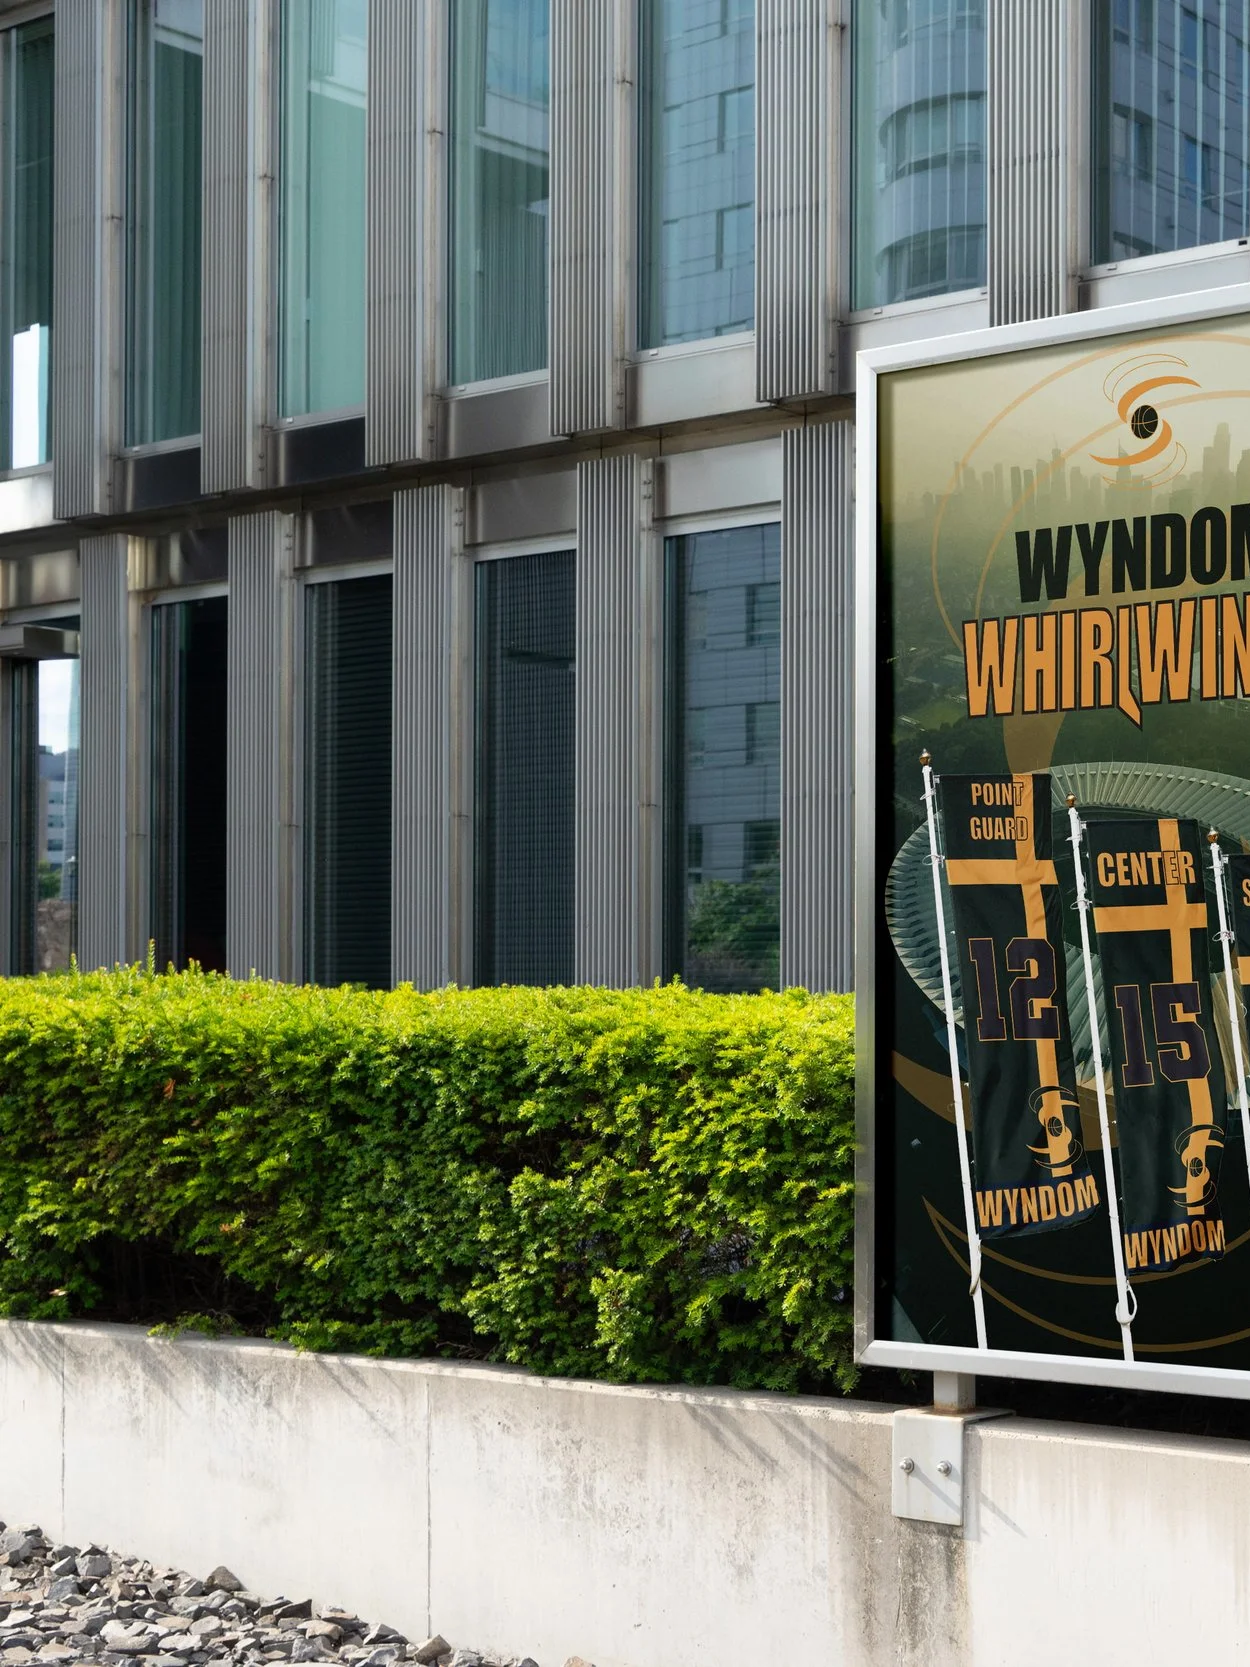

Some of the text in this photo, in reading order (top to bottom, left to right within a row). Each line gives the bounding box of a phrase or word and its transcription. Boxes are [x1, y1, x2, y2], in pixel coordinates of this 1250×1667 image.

[971, 781, 1024, 806] POINT
[969, 815, 1029, 841] GUARD
[1097, 850, 1197, 887] CENTER
[968, 936, 1060, 1041] 12
[1114, 981, 1211, 1088] 15
[976, 1173, 1099, 1228] WYNDOM
[1125, 1219, 1226, 1270] WYNDOM
